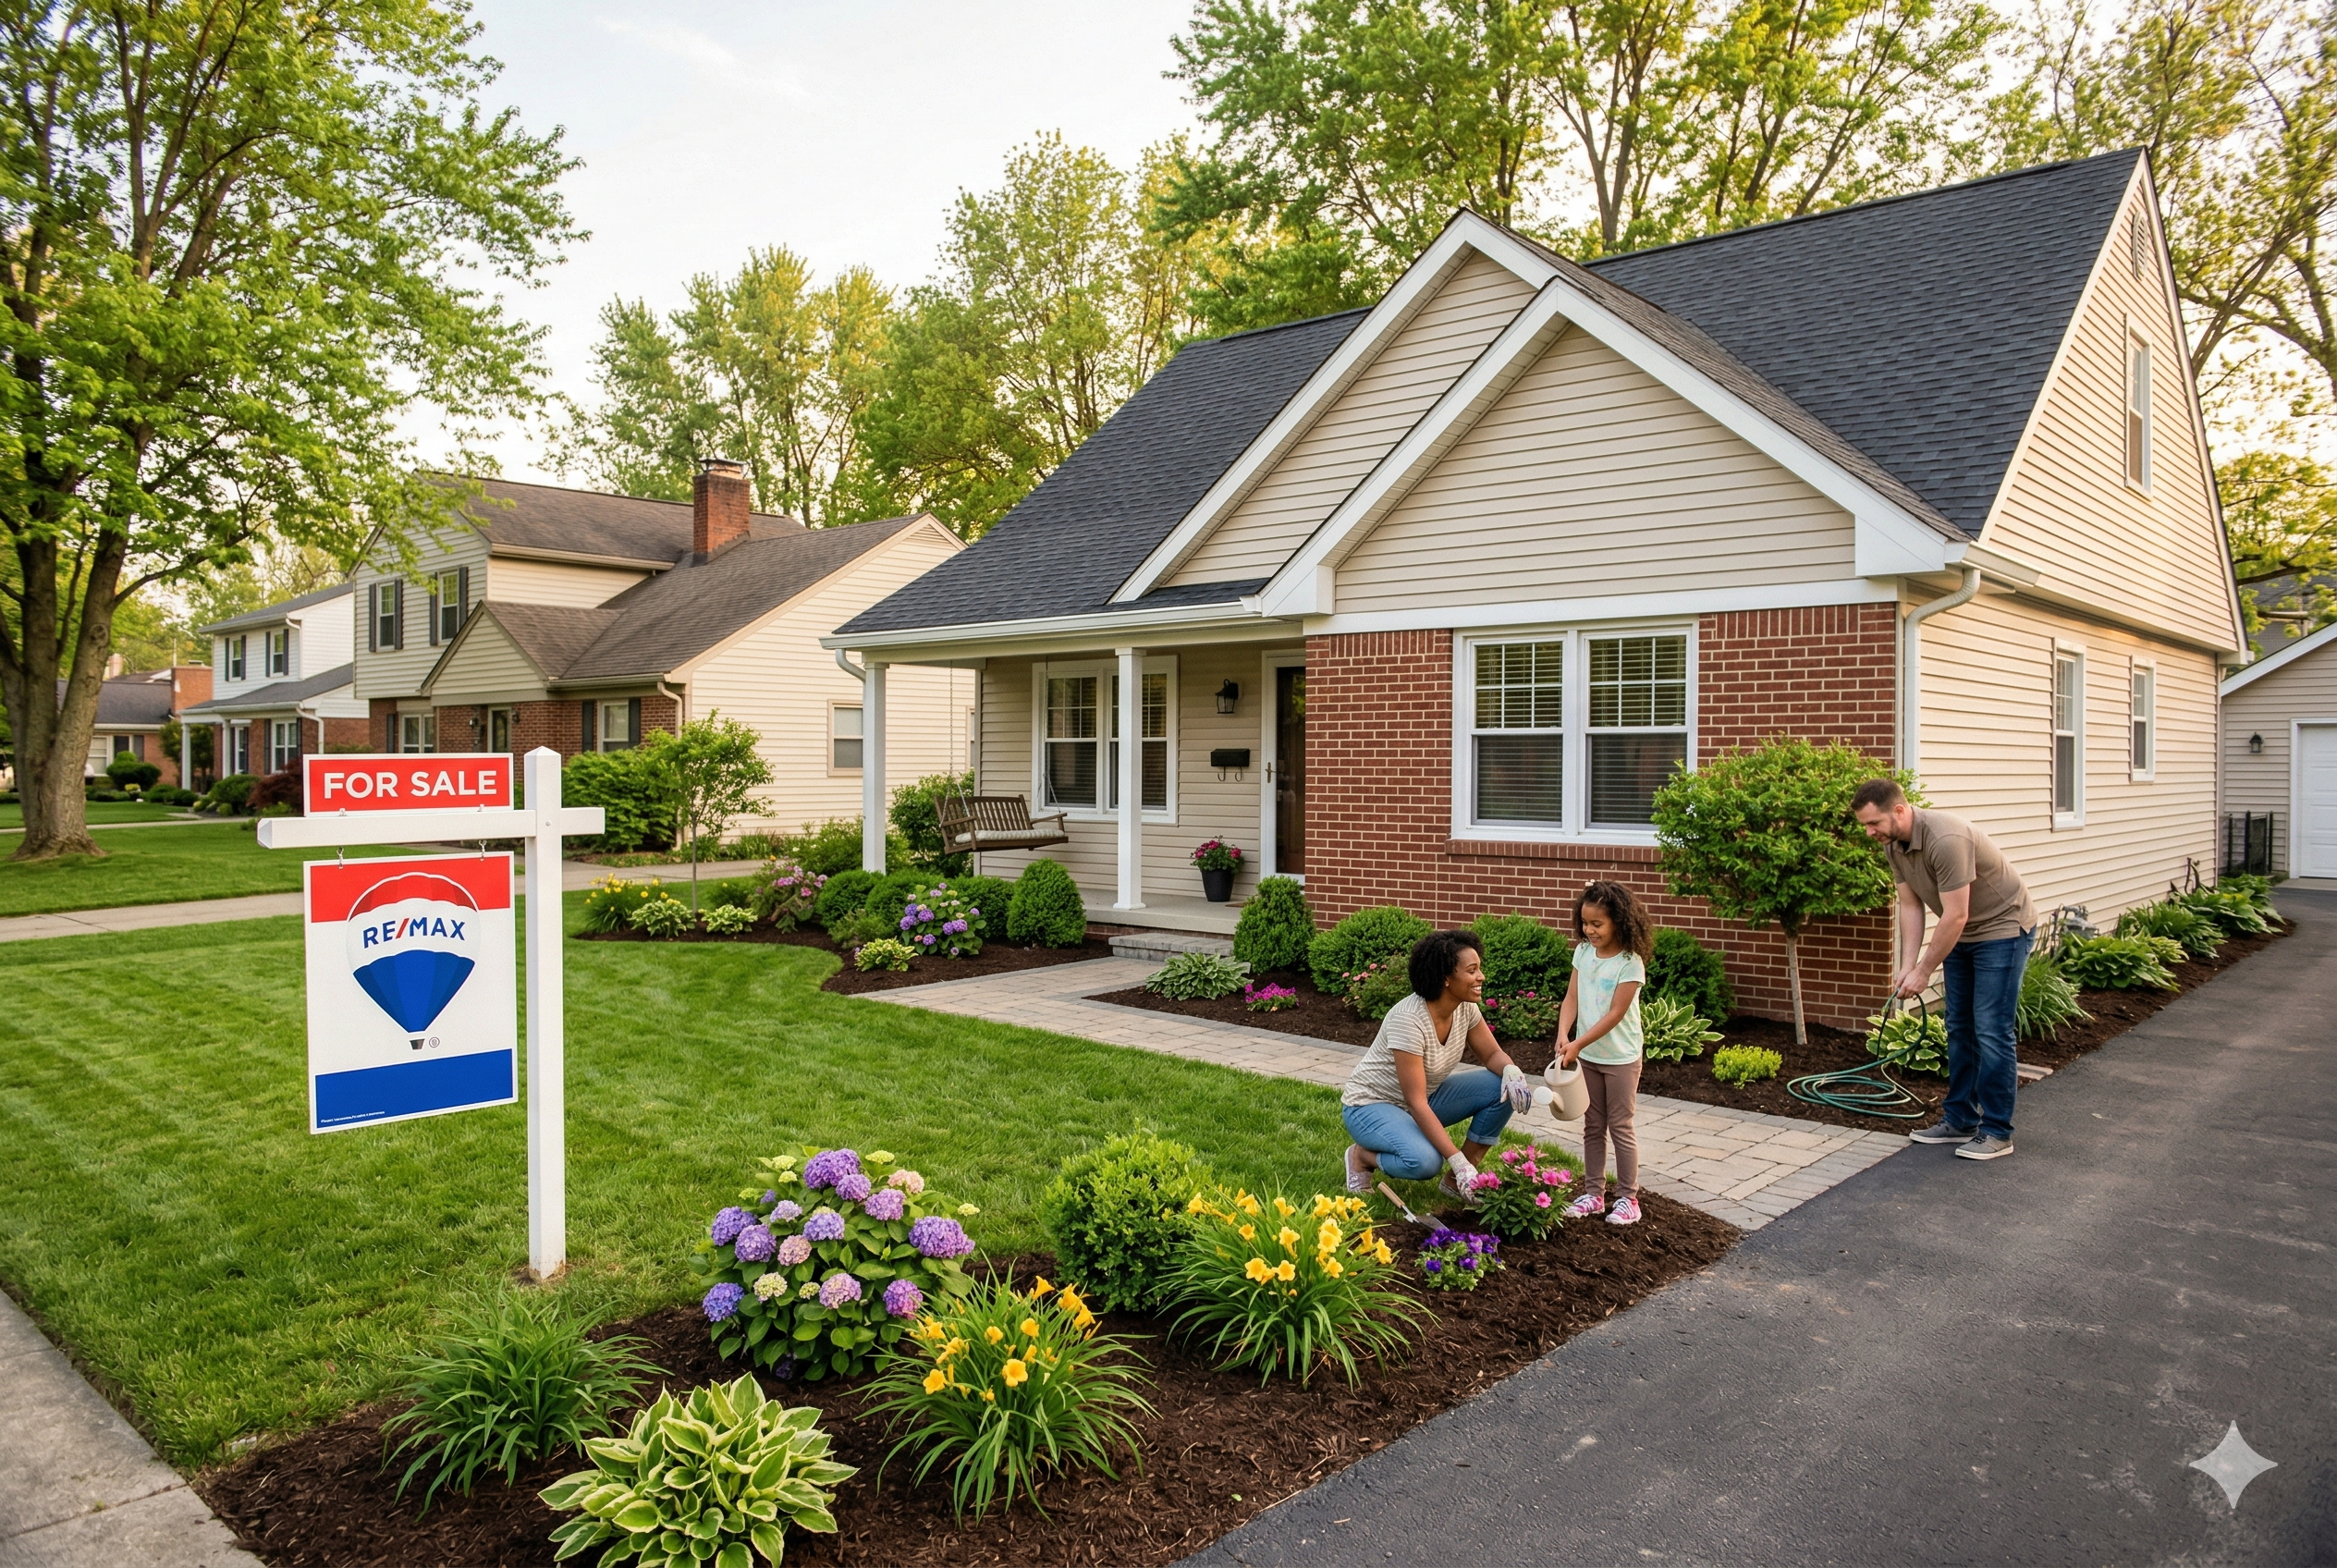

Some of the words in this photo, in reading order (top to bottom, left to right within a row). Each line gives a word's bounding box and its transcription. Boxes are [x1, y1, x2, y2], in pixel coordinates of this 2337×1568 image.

[324, 771, 398, 799] FOR
[410, 770, 497, 797] SALE
[362, 916, 466, 949] RE/MAX
